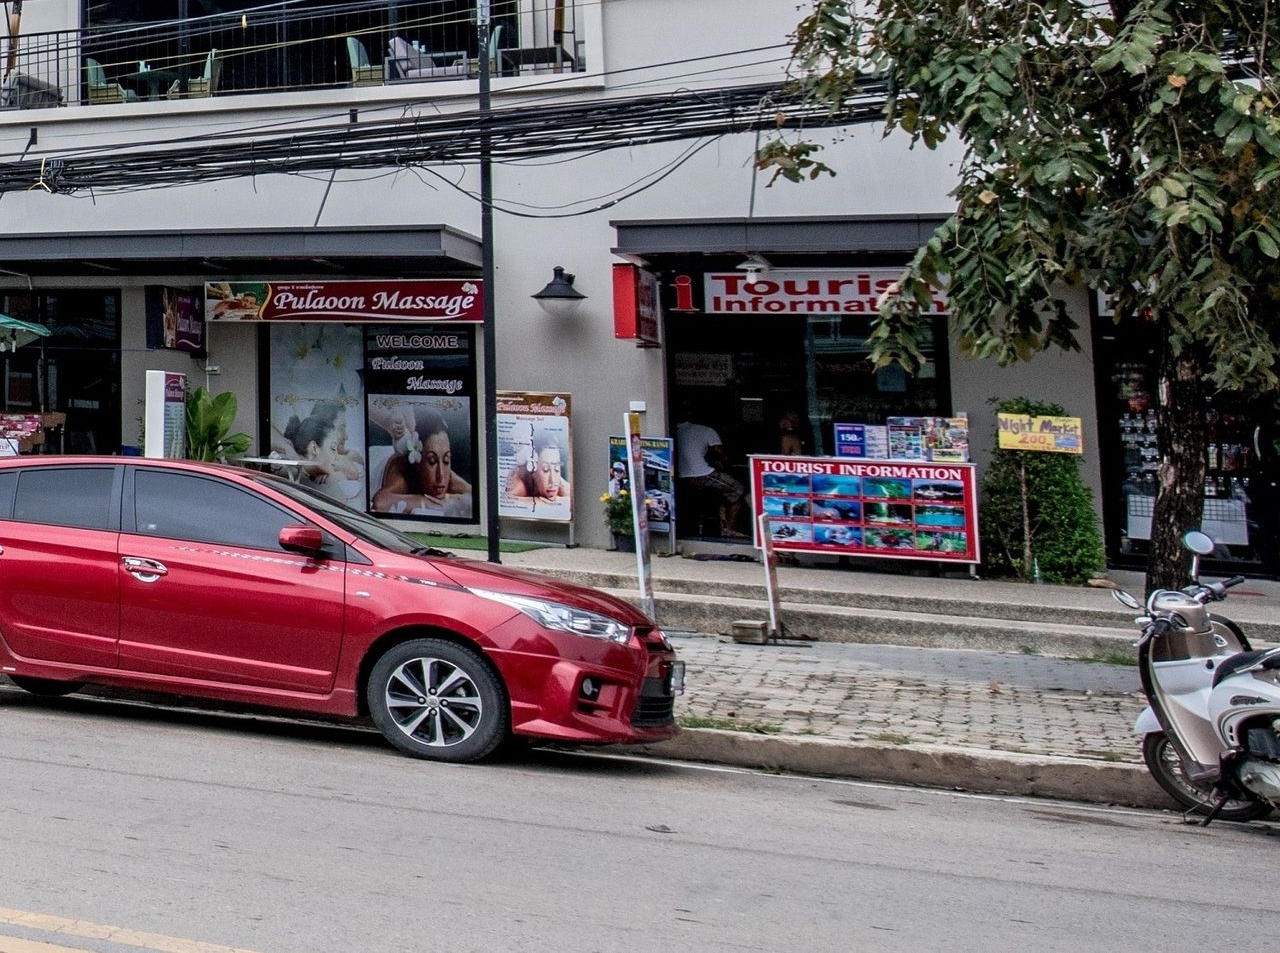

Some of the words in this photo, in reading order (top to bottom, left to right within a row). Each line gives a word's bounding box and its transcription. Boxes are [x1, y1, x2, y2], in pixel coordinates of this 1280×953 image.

[711, 274, 938, 295] Touris
[274, 290, 365, 310] Pulaoon
[371, 291, 475, 315] Massage
[713, 296, 946, 312] Informaton
[376, 335, 458, 348] WELCOME
[372, 356, 424, 370] Pulaoon
[406, 375, 463, 394] Massage
[999, 417, 1033, 434] Night
[1040, 419, 1079, 434] Market
[761, 460, 834, 475] TOURIST
[840, 464, 962, 480] INFORMATION
